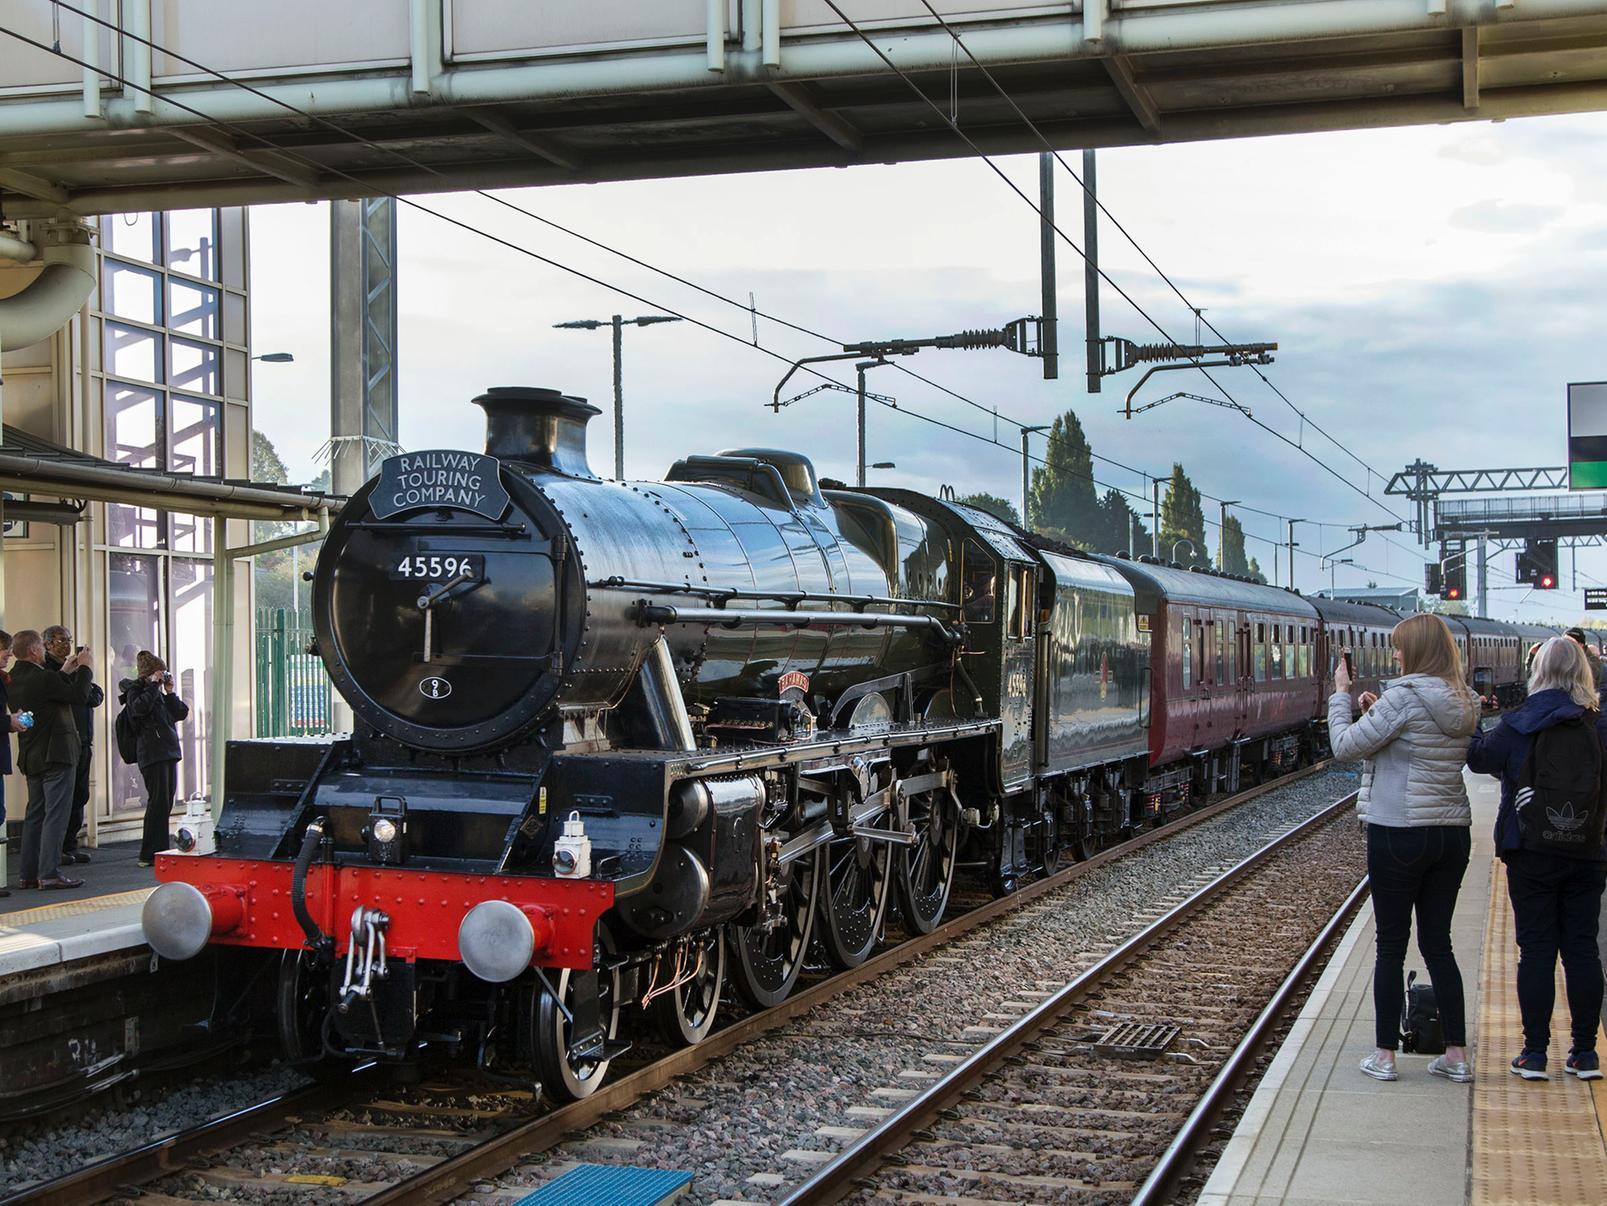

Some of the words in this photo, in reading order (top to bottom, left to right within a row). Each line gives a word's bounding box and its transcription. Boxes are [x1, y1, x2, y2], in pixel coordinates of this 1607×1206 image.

[400, 453, 480, 472] RAILWAY
[397, 470, 482, 490] TOURING
[393, 487, 486, 508] COMPANY
[397, 556, 472, 578] 45596
